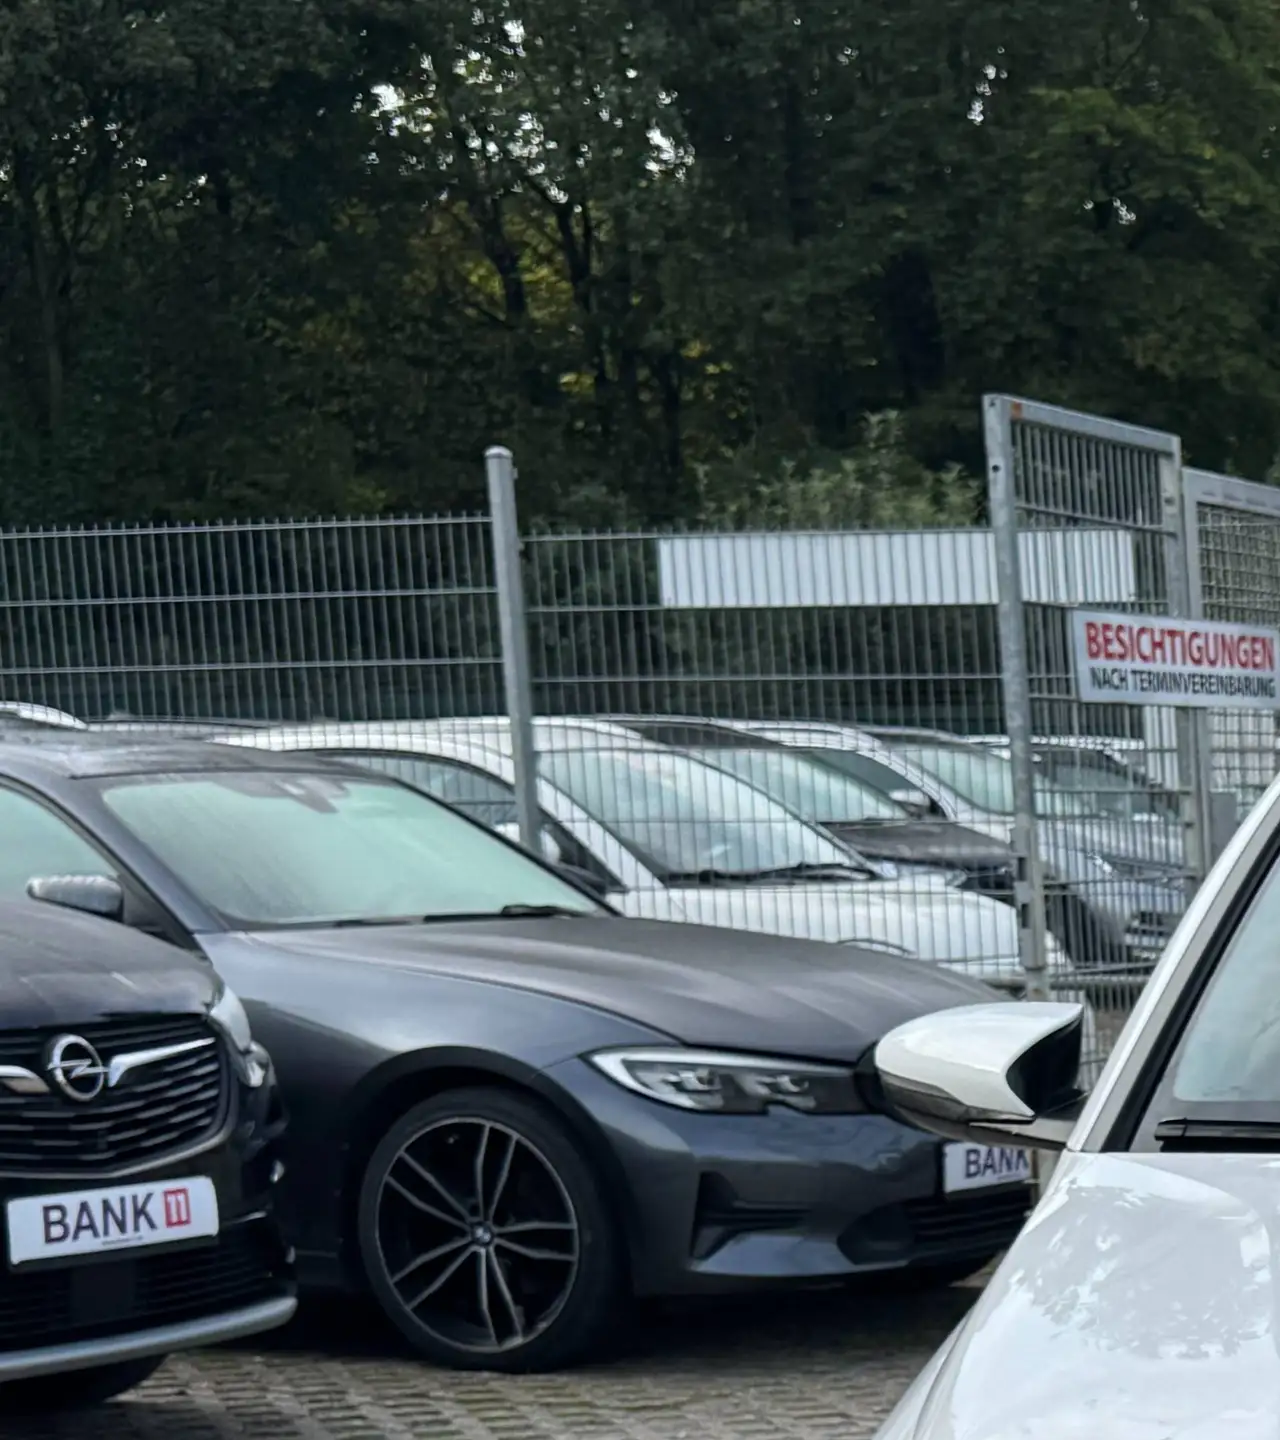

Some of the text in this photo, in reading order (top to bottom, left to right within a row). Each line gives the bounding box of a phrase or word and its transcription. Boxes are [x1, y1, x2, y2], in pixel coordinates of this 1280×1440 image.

[1085, 621, 1275, 671] BESICHTIGUNGEN
[1089, 667, 1276, 698] NACH TERMINVEREINBARUNG
[42, 1190, 189, 1244] BANK 11
